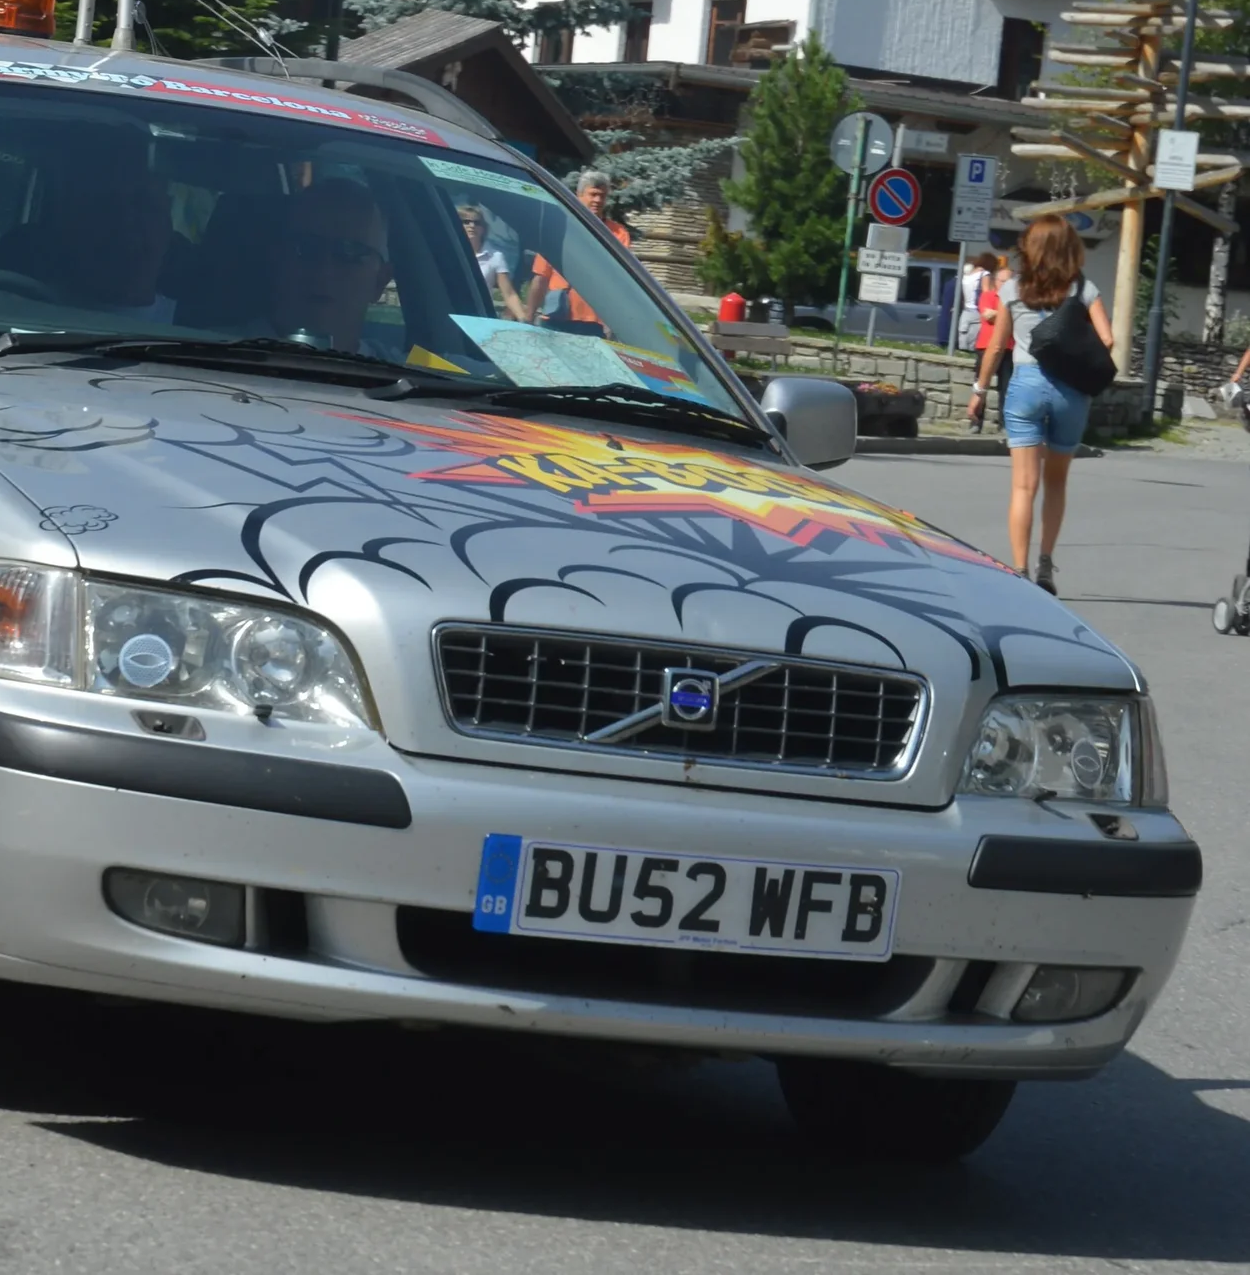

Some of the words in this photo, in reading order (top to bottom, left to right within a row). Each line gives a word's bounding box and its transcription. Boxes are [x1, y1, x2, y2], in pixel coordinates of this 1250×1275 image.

[162, 79, 352, 120] Barcelona
[972, 162, 983, 180] P
[481, 894, 507, 916] GB
[525, 847, 727, 933] BU52
[748, 866, 888, 943] WFB
